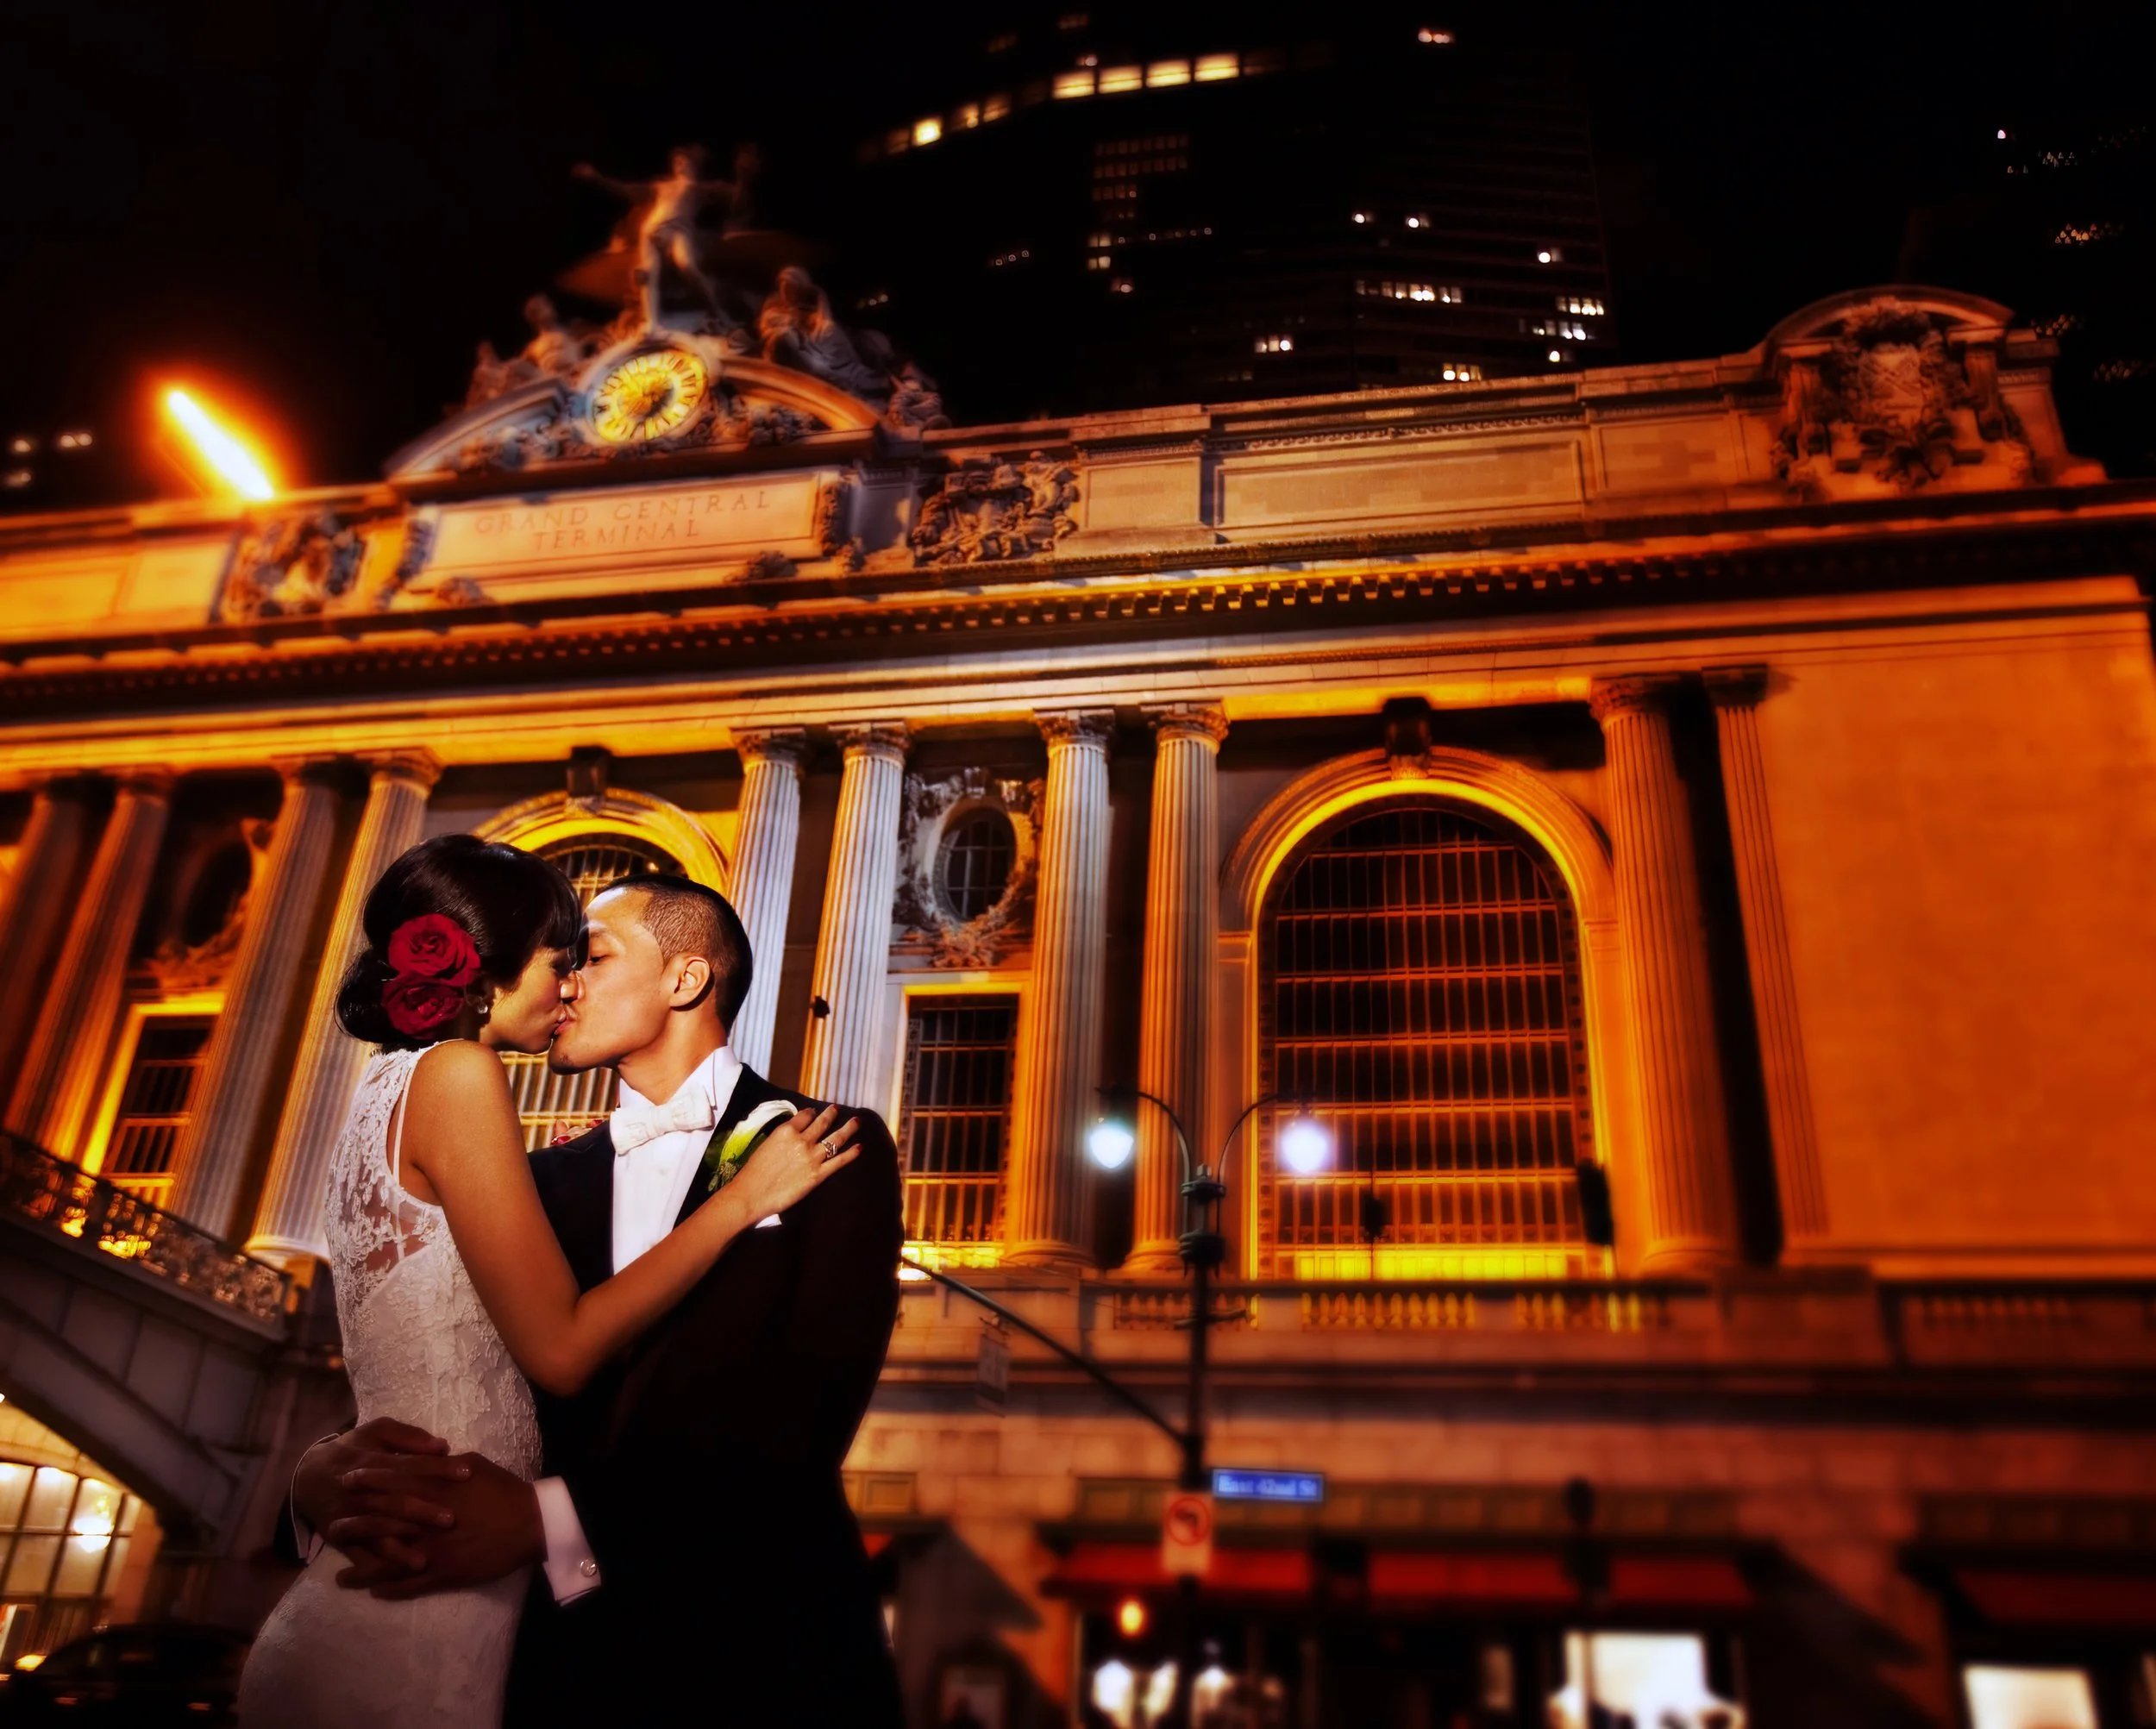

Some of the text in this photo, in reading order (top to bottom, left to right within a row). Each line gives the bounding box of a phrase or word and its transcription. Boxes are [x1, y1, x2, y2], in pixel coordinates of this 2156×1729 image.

[475, 491, 771, 535] GRAND CENTRAL
[533, 519, 700, 551] TERMINAL
